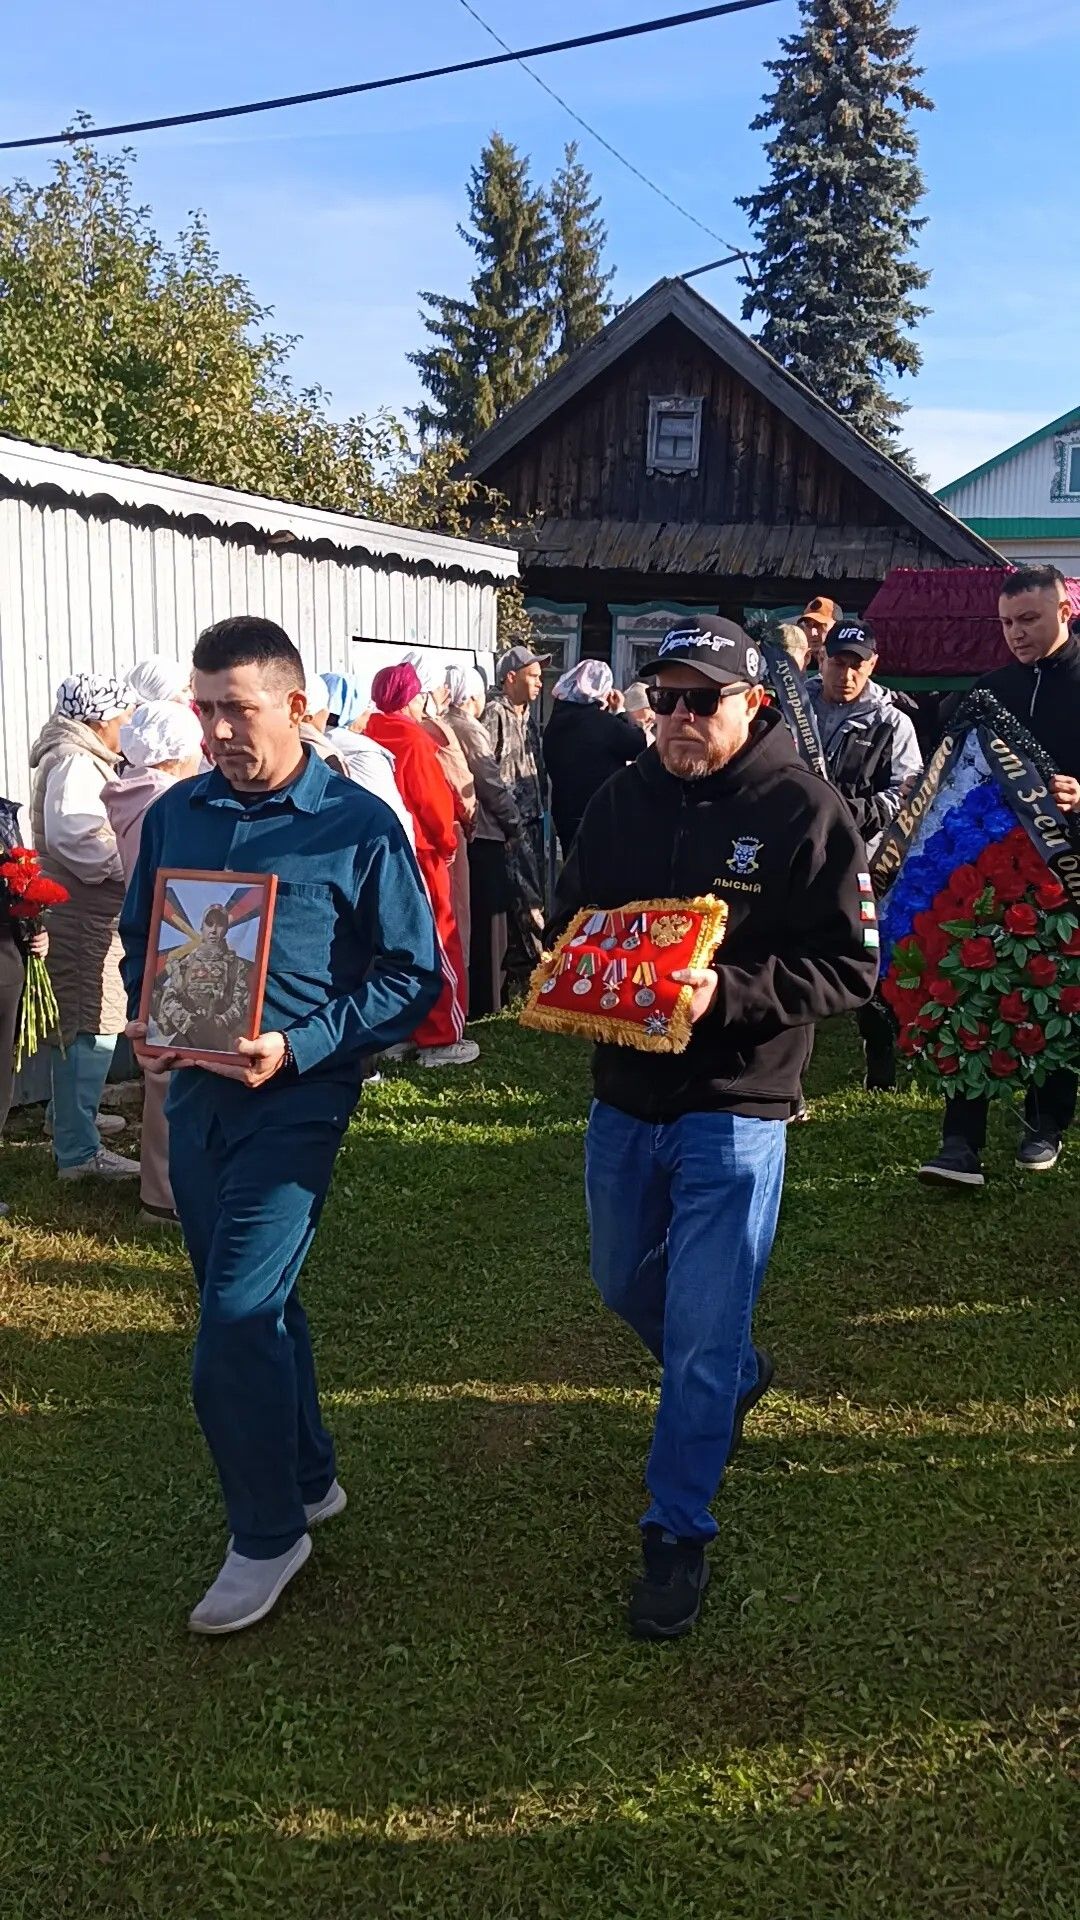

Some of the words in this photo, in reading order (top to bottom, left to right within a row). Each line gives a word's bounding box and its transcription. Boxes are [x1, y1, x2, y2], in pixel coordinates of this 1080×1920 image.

[838, 628, 865, 641] UFC
[990, 738, 1027, 781] от
[1016, 785, 1070, 848] 3-ей
[712, 877, 762, 893] ЛЫСЫЙ
